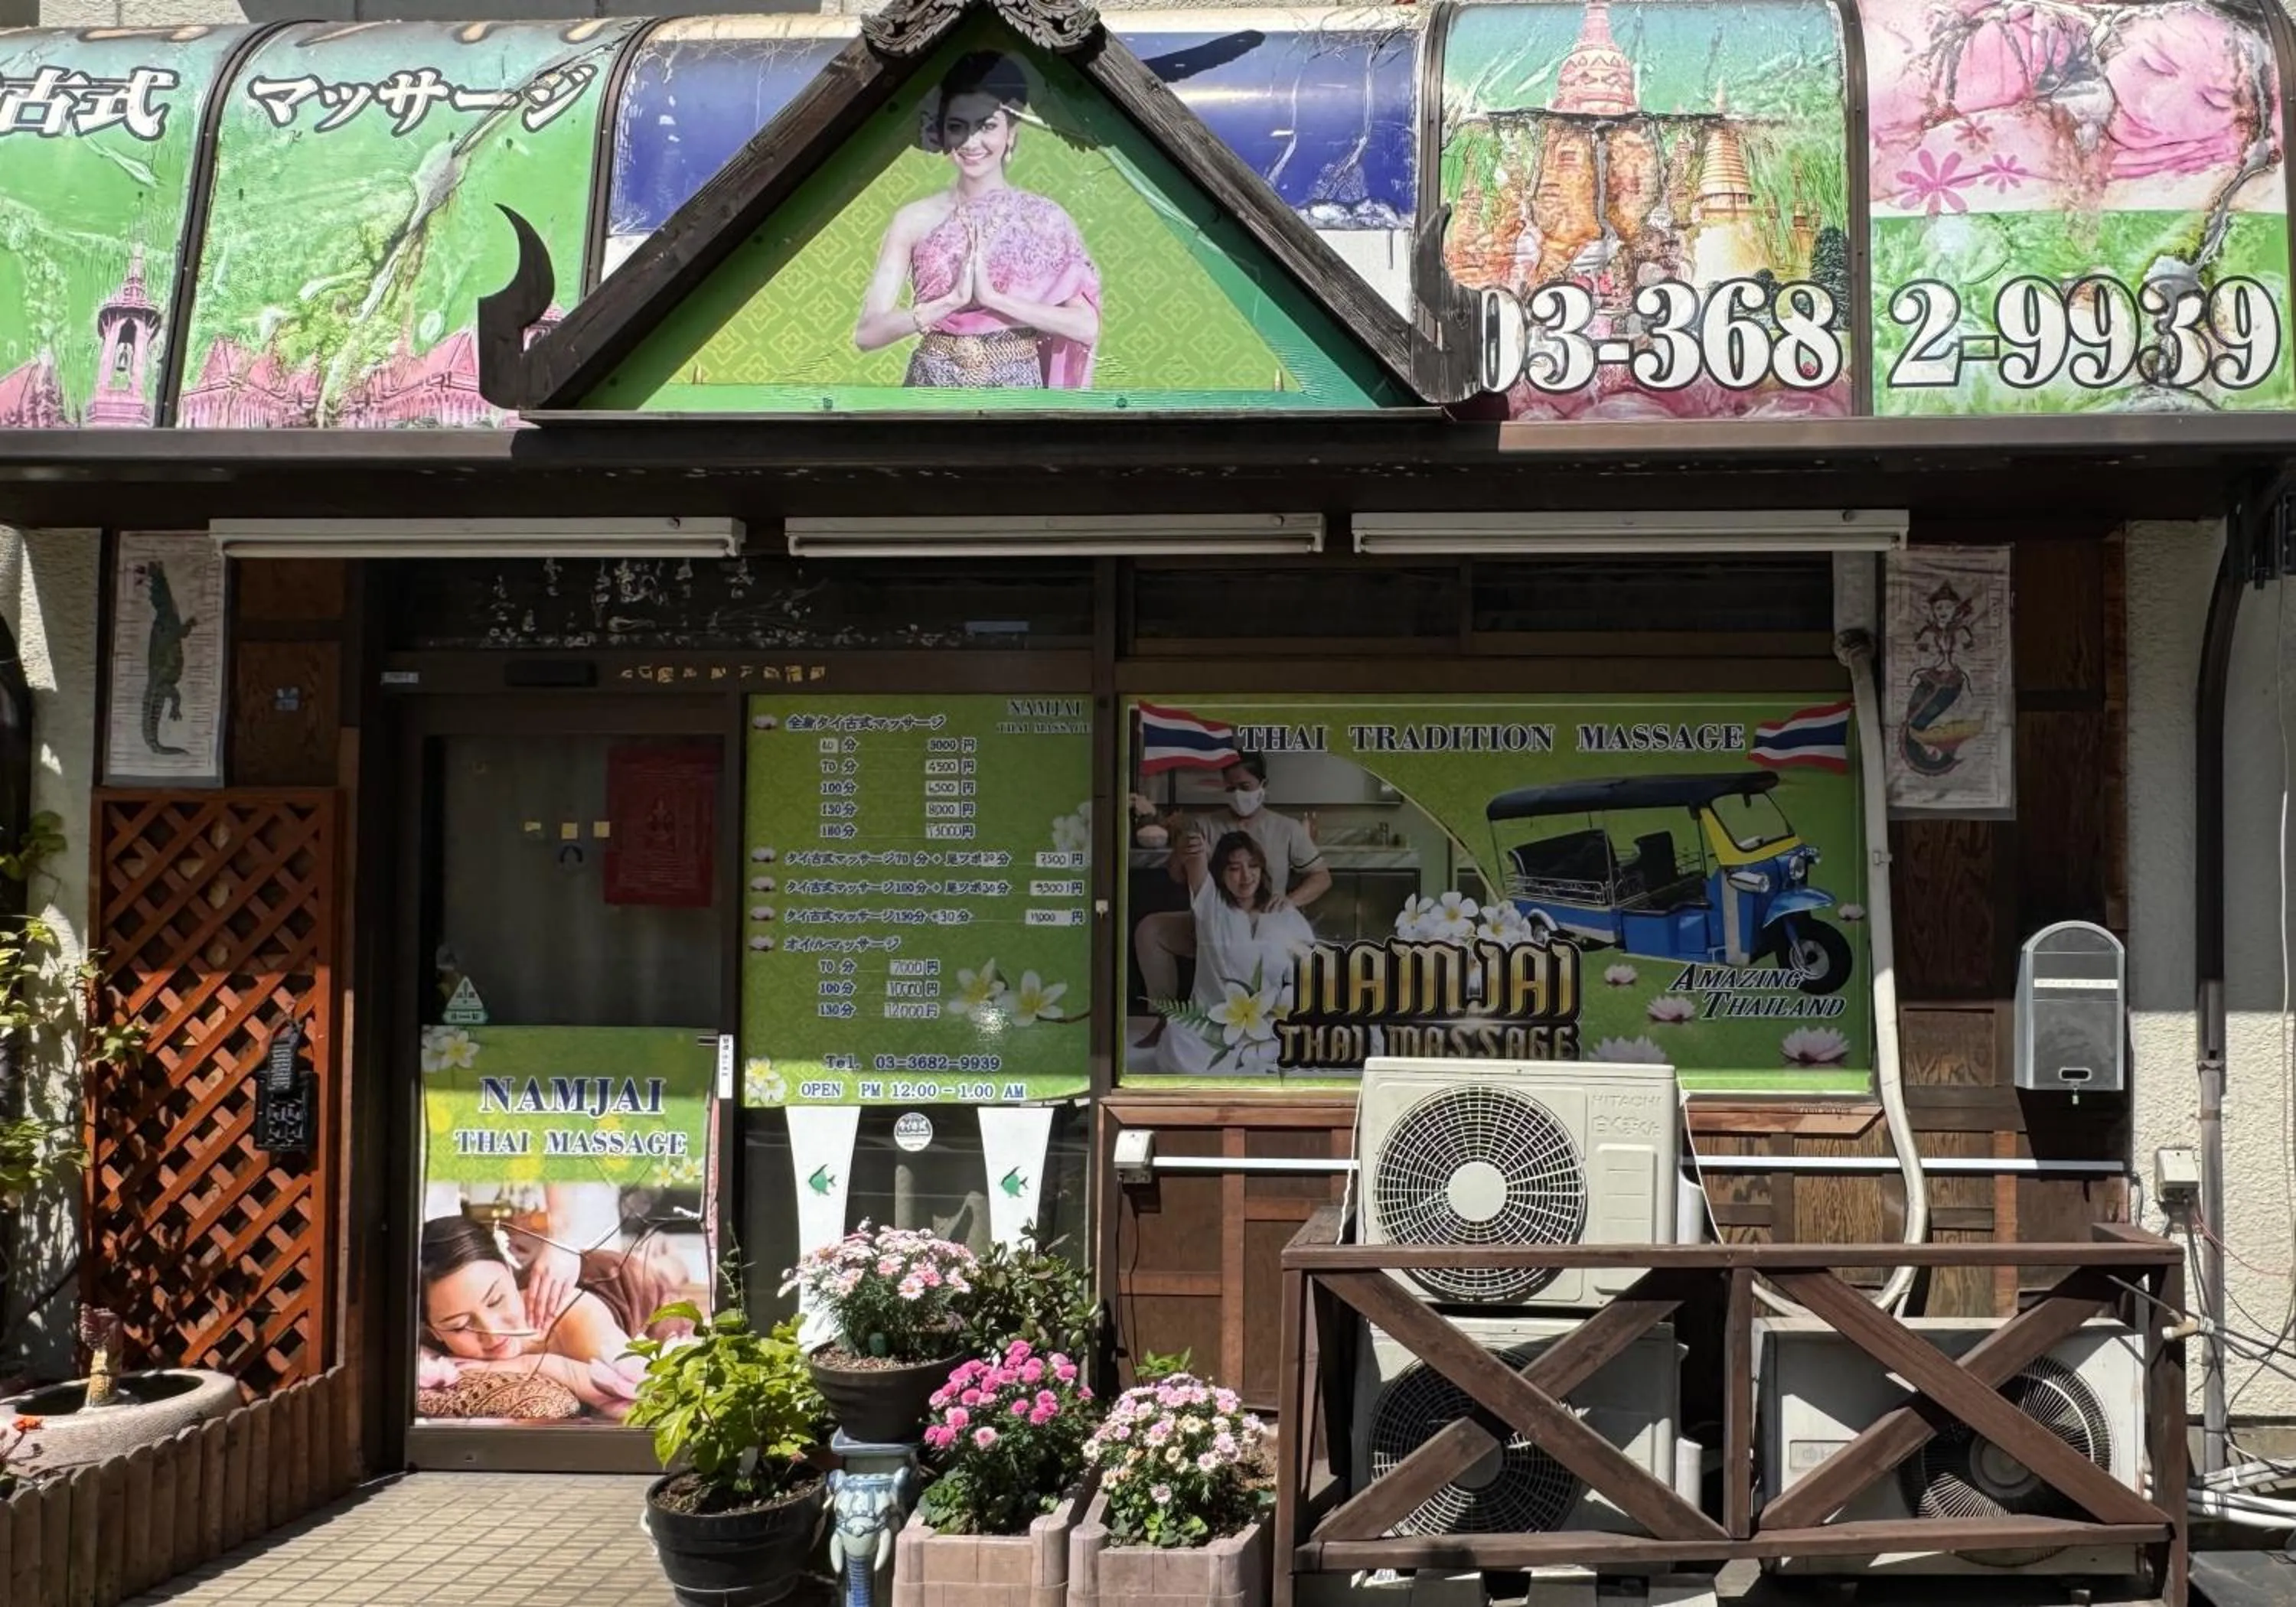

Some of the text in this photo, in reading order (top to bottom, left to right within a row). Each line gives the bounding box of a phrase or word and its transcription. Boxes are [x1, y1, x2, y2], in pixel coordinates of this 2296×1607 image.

[0, 64, 598, 139] 古式 マッサージ
[1238, 723, 1746, 753] THAI TRADITION MASSAGE
[1293, 940, 1581, 1020] NAMJAI
[1671, 963, 1802, 993] AMAZING
[1701, 990, 1845, 1020] THAILAND
[1277, 1023, 1368, 1062] THAI
[875, 1055, 1001, 1071] 03-3682-9939
[479, 1077, 666, 1118] NAMJAI
[801, 1082, 842, 1097] OPEN
[859, 1083, 881, 1097] PM
[1003, 1083, 1026, 1098] AM
[454, 1129, 687, 1156] THAI MASSAGE
